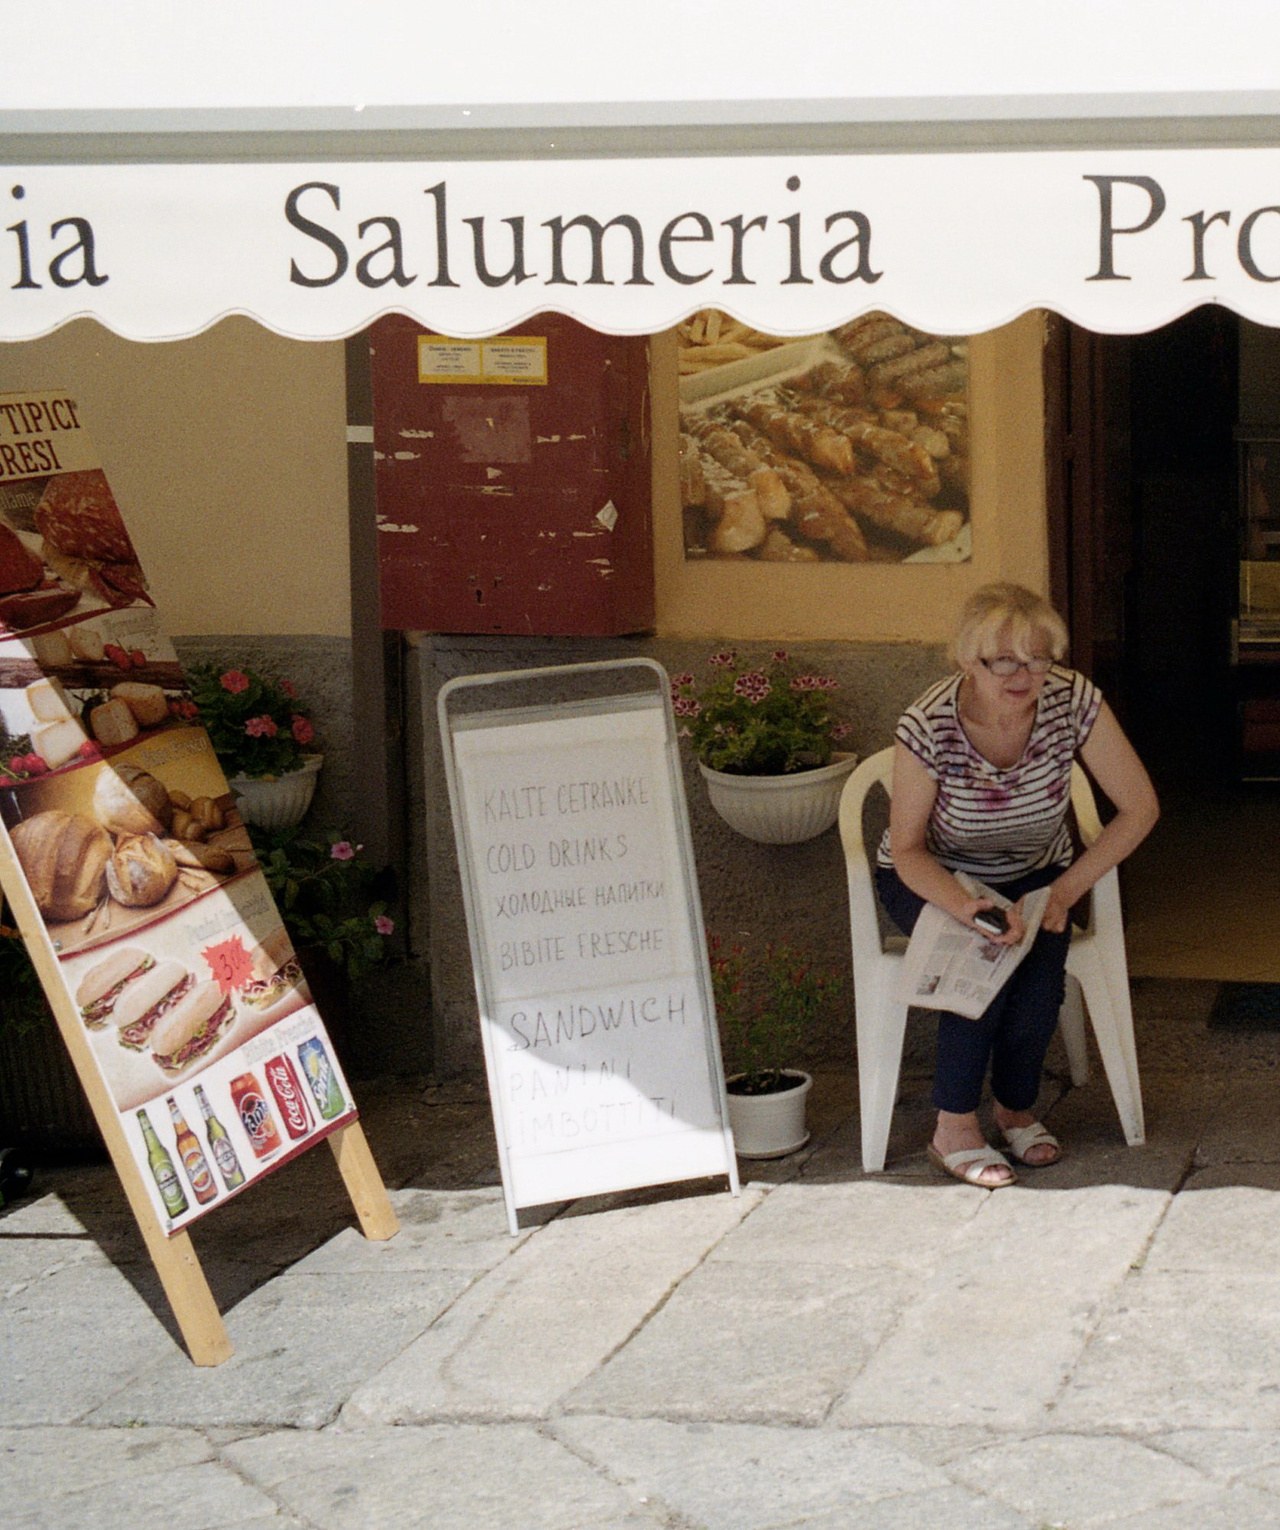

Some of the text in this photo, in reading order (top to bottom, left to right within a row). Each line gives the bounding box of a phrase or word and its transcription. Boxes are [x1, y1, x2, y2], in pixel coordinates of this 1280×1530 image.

[7, 186, 108, 289] ia
[286, 177, 882, 288] Salumeria
[0, 399, 80, 435] TIPICI
[0, 439, 62, 477] RESI
[484, 786, 547, 823] KALTE
[487, 834, 628, 874] COLD DRINKS
[497, 880, 664, 919] ХОЛОДНЫЕ НАПИТКИ
[500, 928, 663, 971] BIBITE FRESCHE
[509, 993, 686, 1050] SANDWICH
[510, 1058, 631, 1101] PANINI
